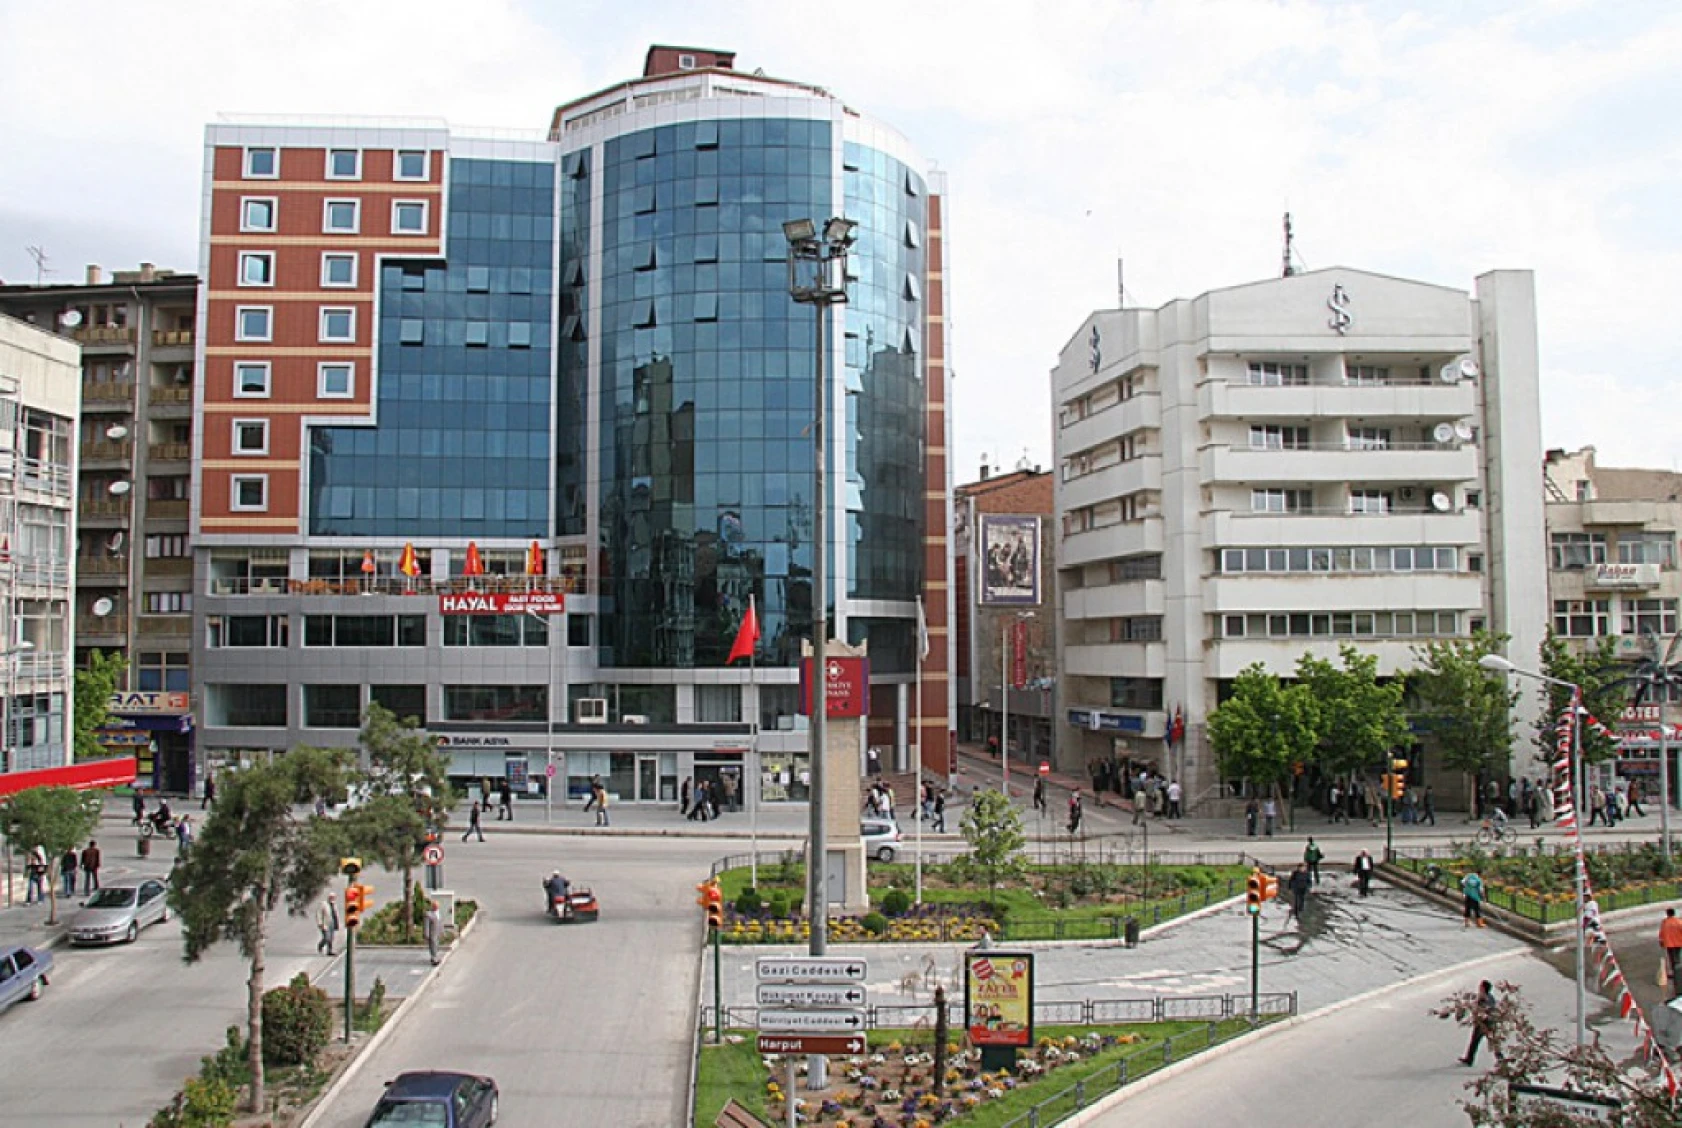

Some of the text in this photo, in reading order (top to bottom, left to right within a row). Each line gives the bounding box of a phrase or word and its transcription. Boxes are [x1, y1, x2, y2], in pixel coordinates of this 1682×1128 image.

[443, 596, 498, 611] HAYAL
[453, 737, 510, 746] BANK ASYA
[761, 965, 844, 976] Gazi Caddesi
[761, 1038, 802, 1052] Harput
